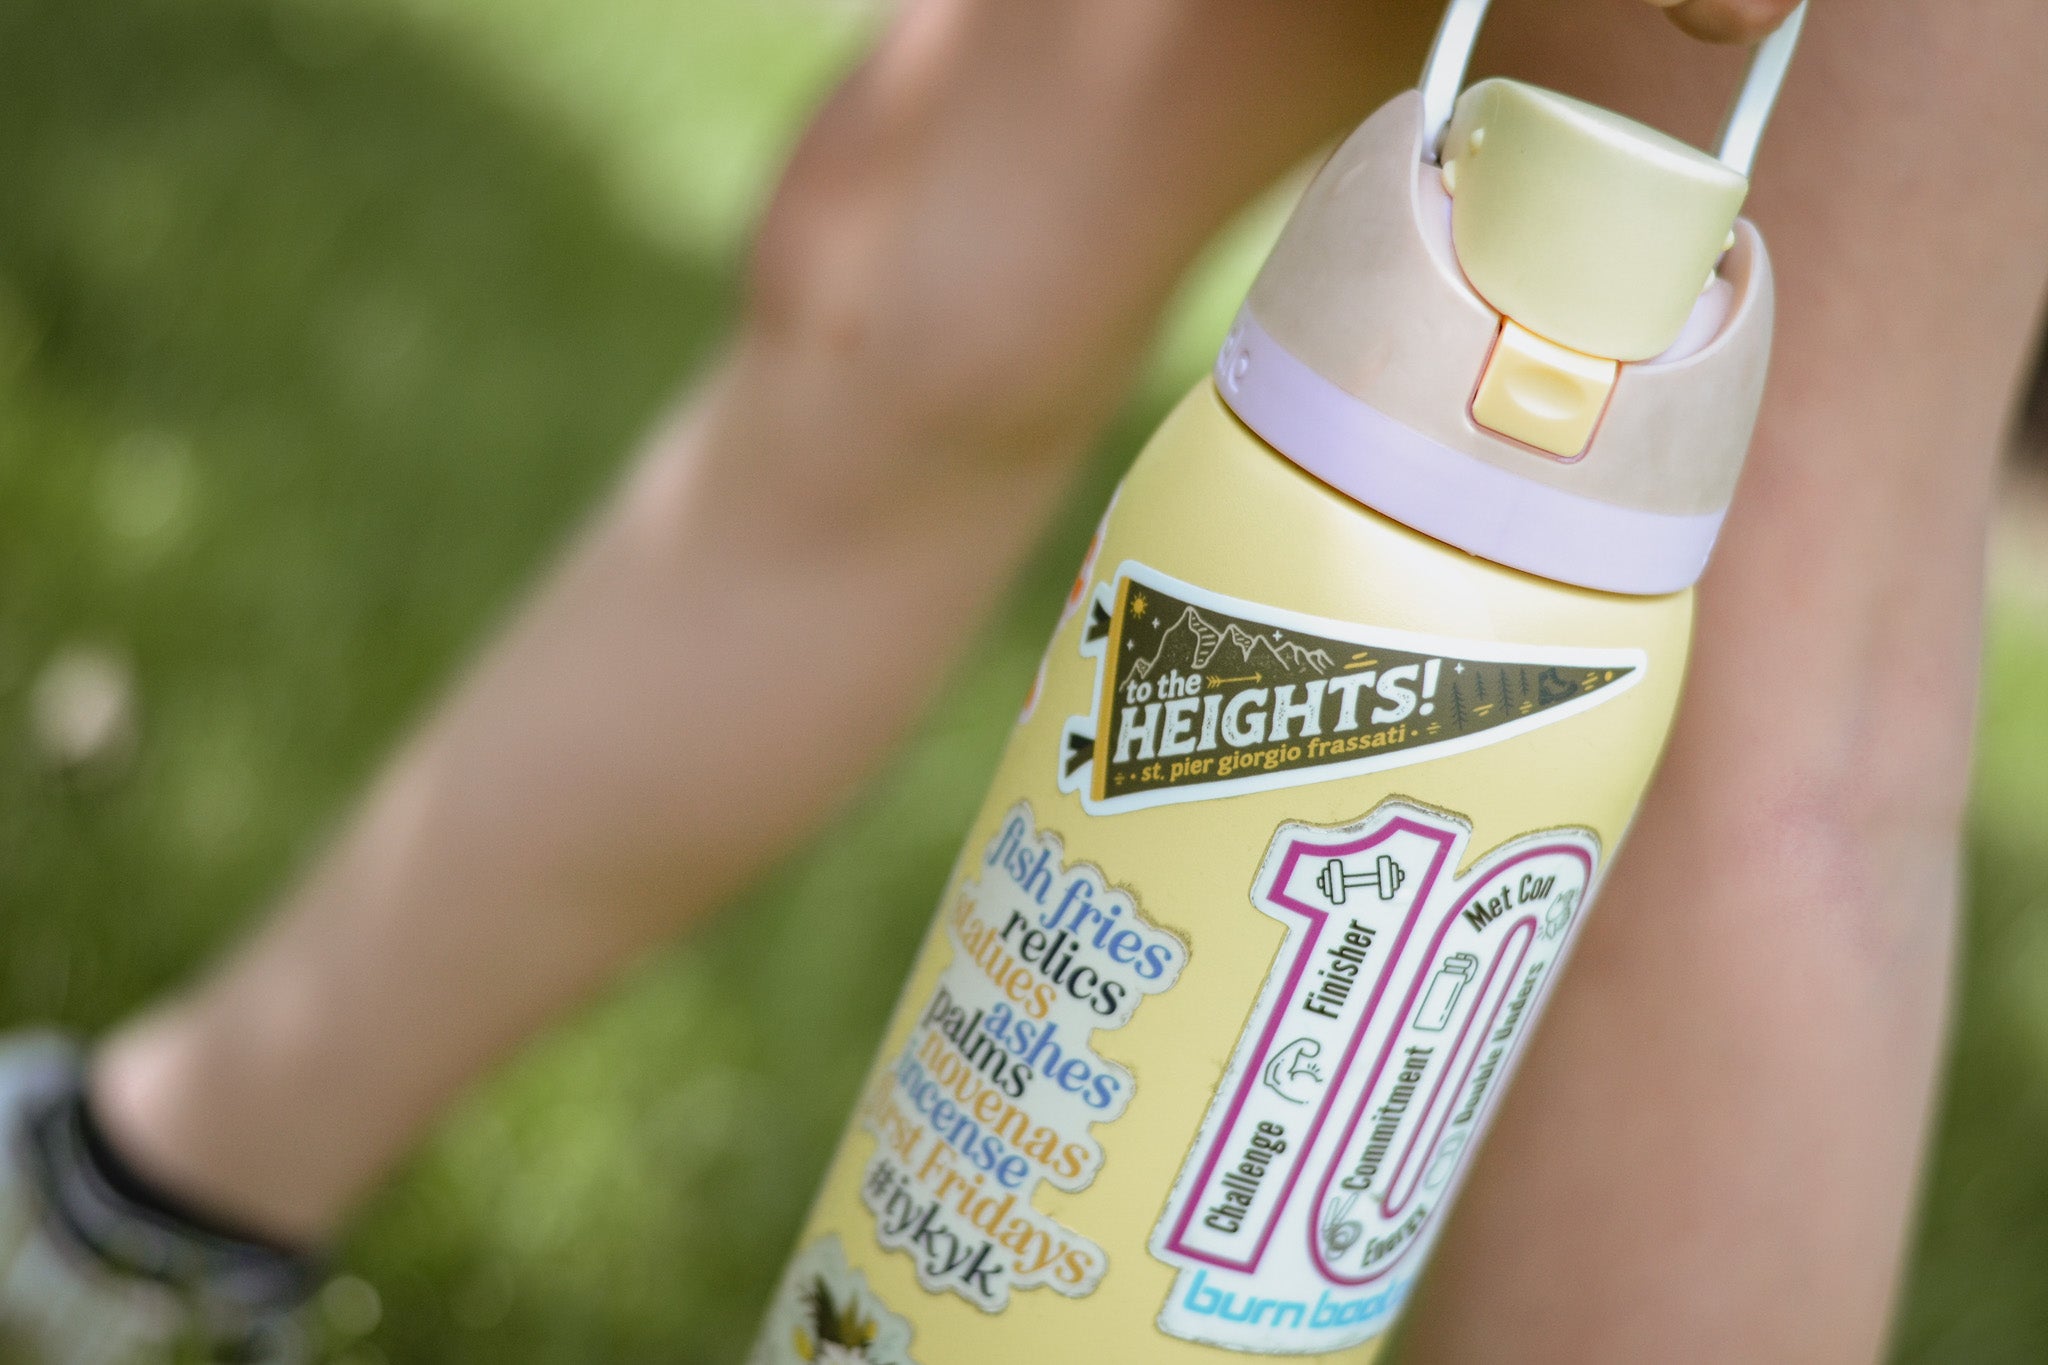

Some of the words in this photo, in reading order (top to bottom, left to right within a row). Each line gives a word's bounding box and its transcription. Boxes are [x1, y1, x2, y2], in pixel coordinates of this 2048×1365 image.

[1112, 657, 1443, 765] HEIGHTS!
[1126, 677, 1157, 705] to
[1162, 668, 1202, 697] the
[1140, 762, 1166, 783] st.
[1170, 752, 1214, 785] pier
[1216, 742, 1303, 778] giorgio
[1305, 723, 1407, 761] frassati
[987, 815, 1055, 905] fish
[1038, 878, 1173, 980] fries
[1462, 885, 1513, 933] Met
[1518, 873, 1556, 905] Con
[1000, 909, 1127, 1016] relics
[1303, 918, 1377, 1020] Finisher
[921, 983, 1033, 1098] palms
[983, 1000, 1121, 1109] ashes
[917, 1030, 1090, 1178] novenas
[1341, 1045, 1435, 1192] Commitment
[867, 1158, 1005, 1298] #iykyk
[916, 1138, 1094, 1285] Fridays
[1203, 1119, 1286, 1234] Challenge
[1184, 1269, 1307, 1328] burn
